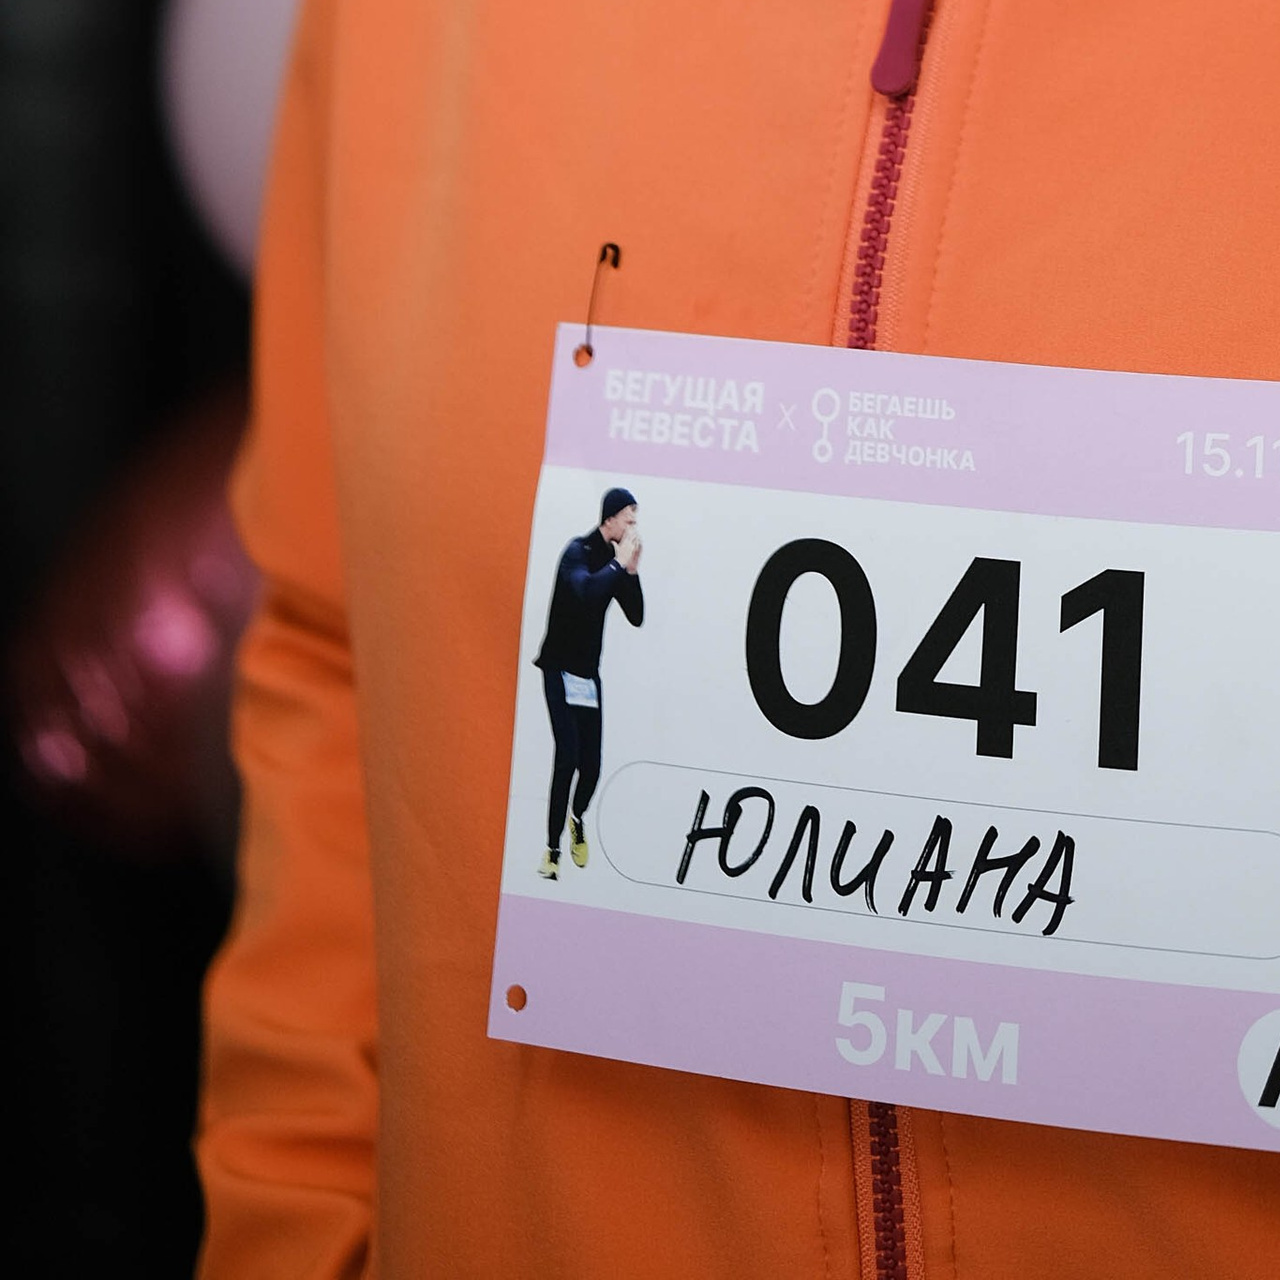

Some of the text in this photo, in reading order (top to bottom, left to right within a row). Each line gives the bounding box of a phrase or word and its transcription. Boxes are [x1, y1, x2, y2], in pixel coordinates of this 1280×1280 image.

[604, 369, 765, 416] БЕГУЩАЯ
[848, 391, 956, 420] БЕГАЕШЬ
[608, 408, 760, 453] НЕВЕСТА
[846, 417, 894, 440] КАК
[844, 440, 976, 472] ДЕВЧОНКА
[744, 537, 1145, 772] 041
[676, 786, 1076, 936] ЮЛИАНА
